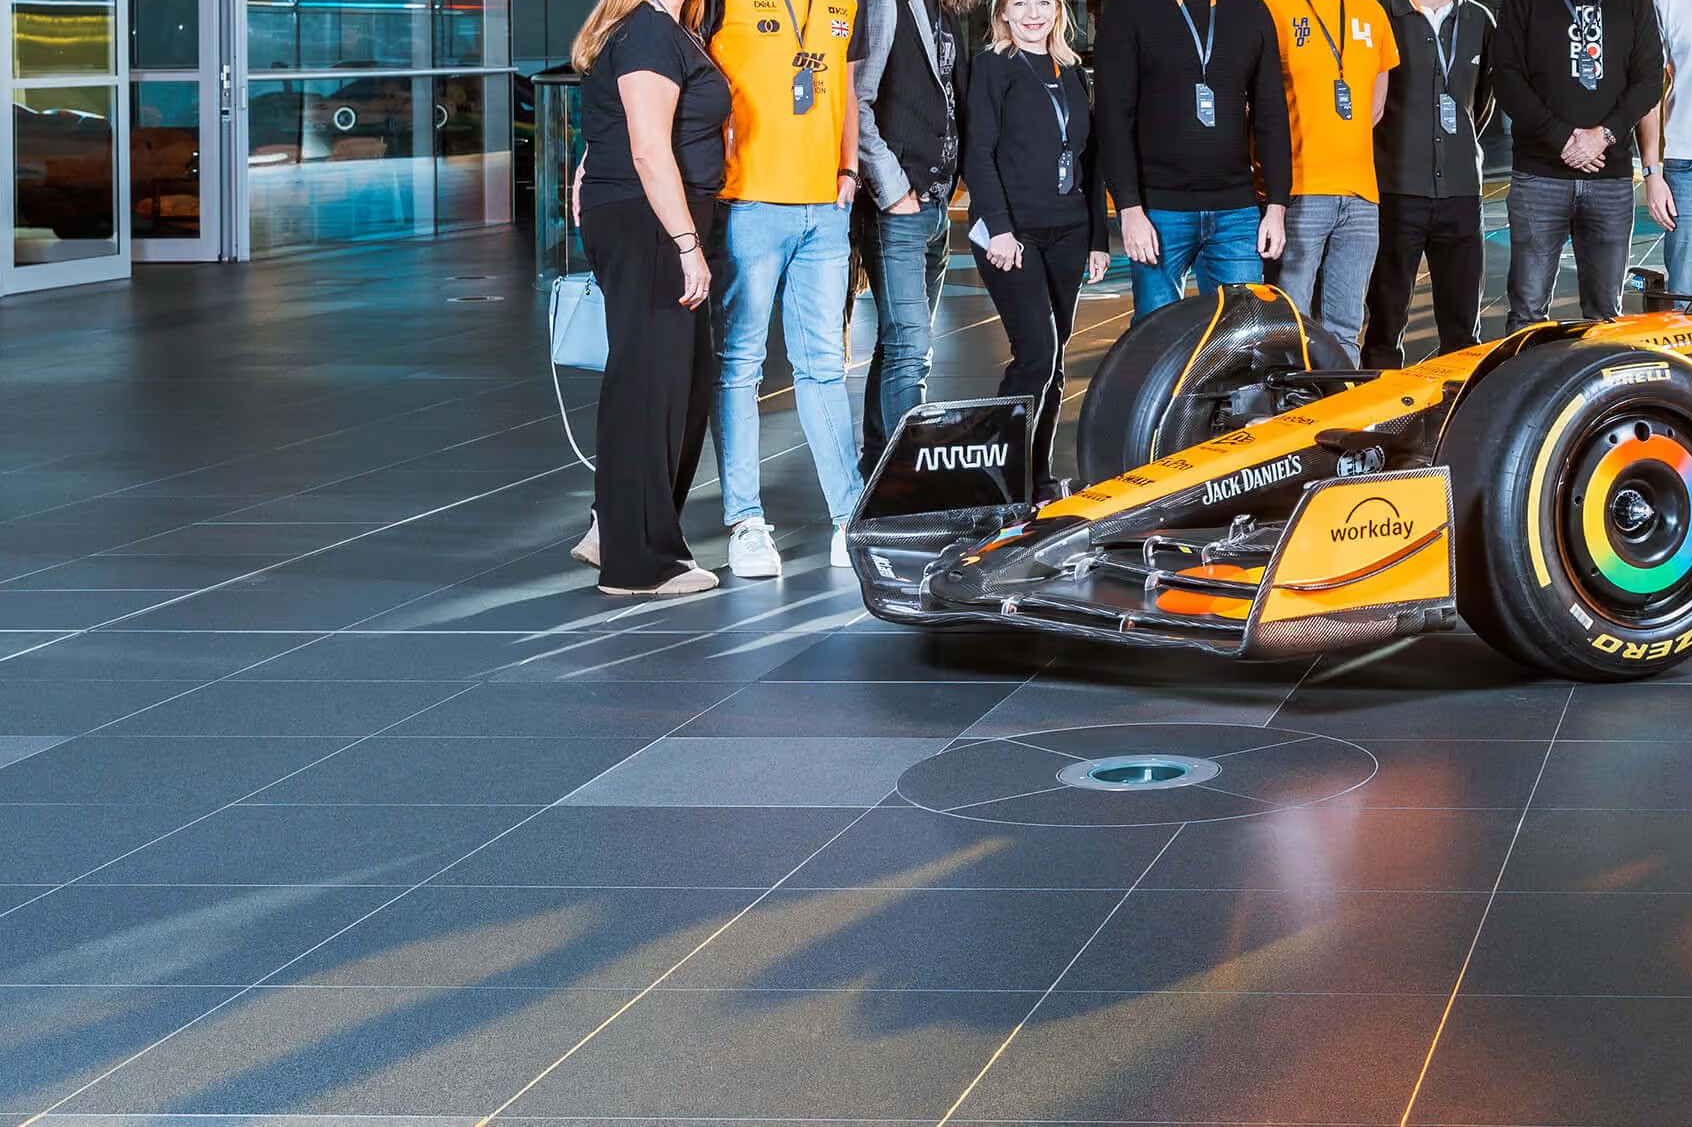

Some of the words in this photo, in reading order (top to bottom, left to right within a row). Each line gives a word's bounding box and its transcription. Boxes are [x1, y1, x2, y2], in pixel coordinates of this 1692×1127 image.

[915, 443, 1008, 472] ARROW
[1202, 477, 1242, 505] JACK
[1242, 454, 1303, 490] DANIEL'S
[1331, 518, 1414, 542] workday
